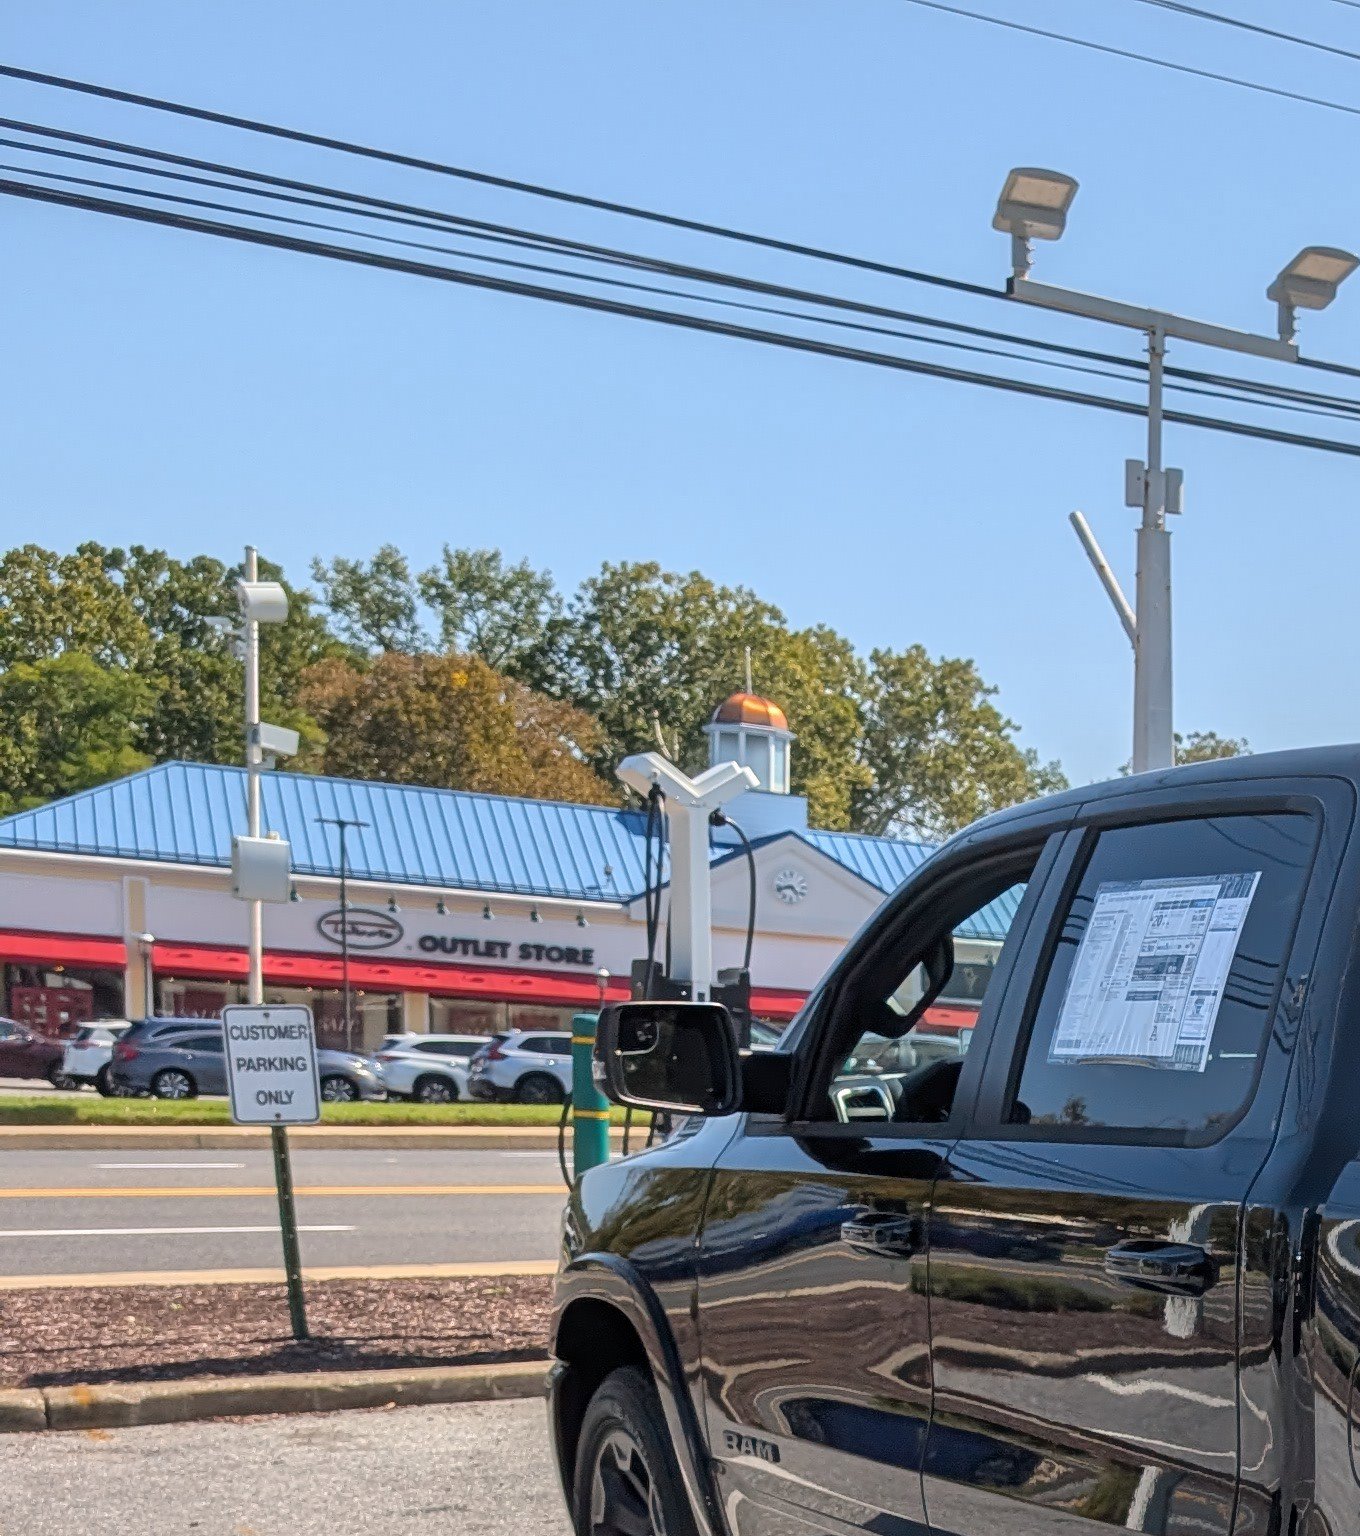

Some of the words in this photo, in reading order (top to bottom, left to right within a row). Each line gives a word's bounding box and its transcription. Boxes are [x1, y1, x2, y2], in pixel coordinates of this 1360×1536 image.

[418, 935, 511, 959] OUTLET
[519, 942, 594, 965] STORE
[230, 1025, 308, 1040] CUSTOMER
[236, 1056, 308, 1072] PARKING
[256, 1090, 295, 1106] ONLY
[723, 1429, 780, 1463] RAM
